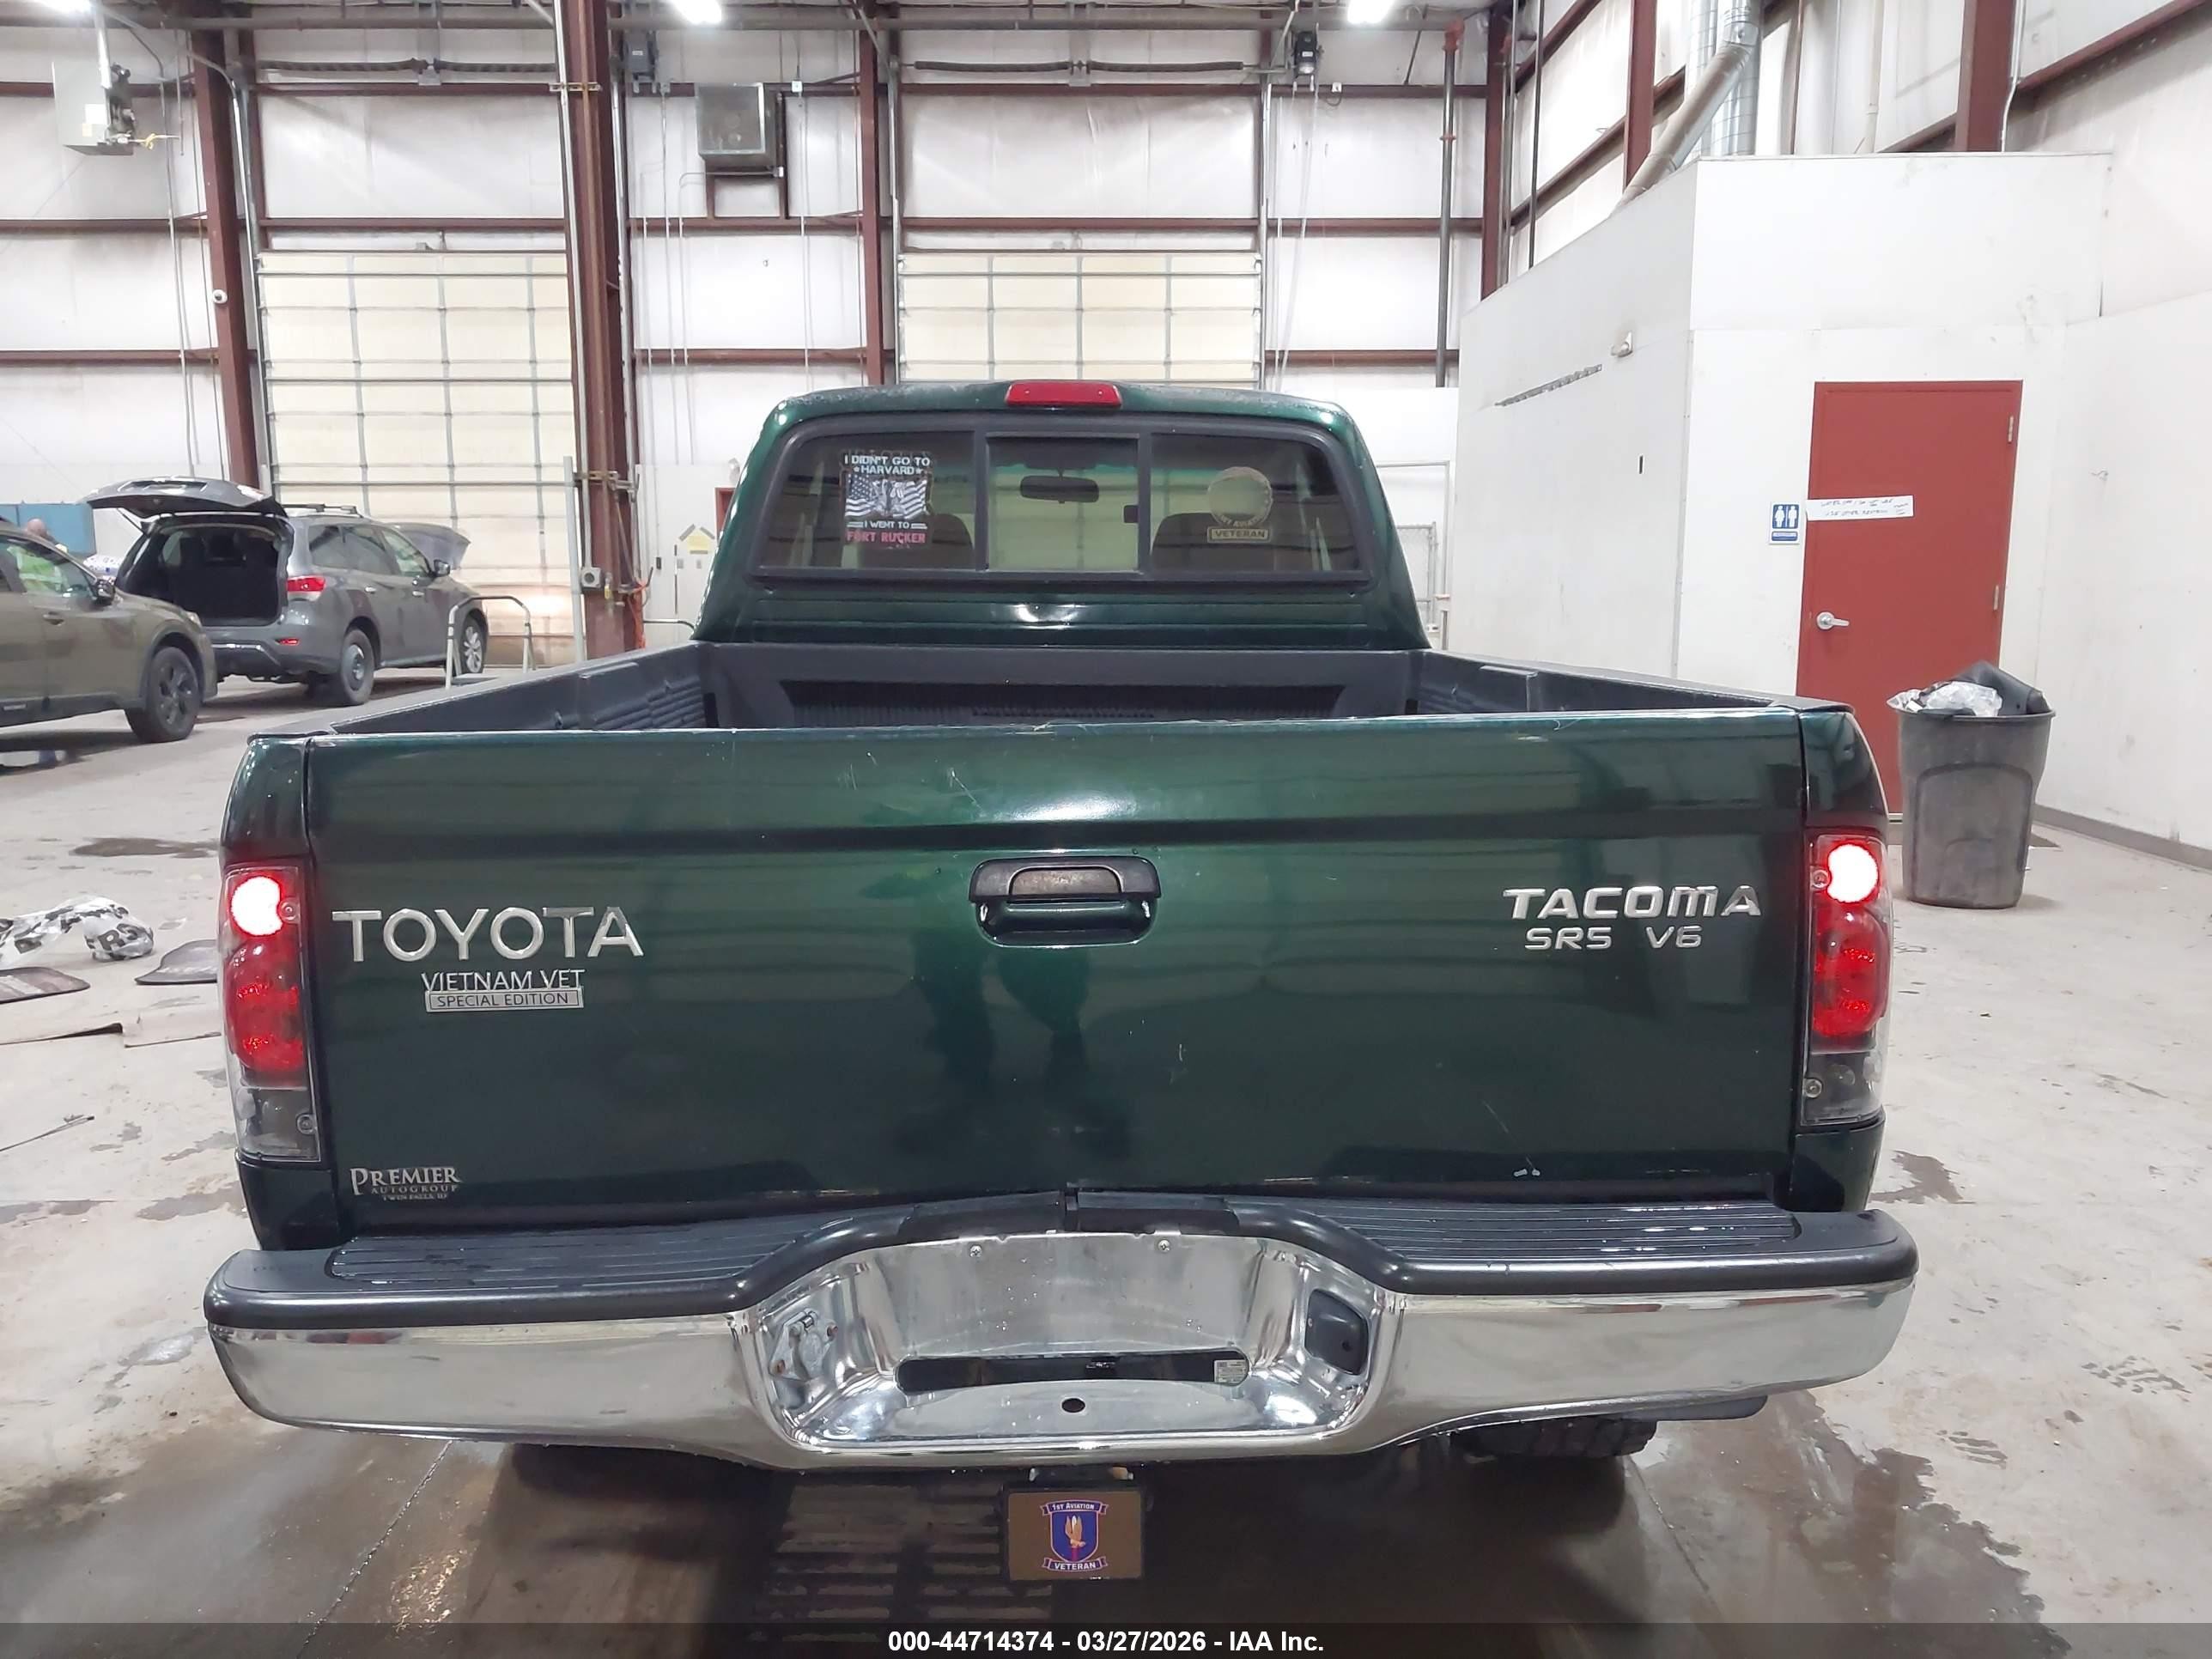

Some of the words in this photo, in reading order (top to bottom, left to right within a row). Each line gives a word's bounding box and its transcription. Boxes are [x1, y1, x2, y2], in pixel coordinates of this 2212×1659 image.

[844, 455, 848, 464] I
[851, 455, 888, 465] DIDN'T
[892, 457, 910, 466] GO
[915, 457, 930, 466] TO
[860, 465, 915, 475] HARVARD
[870, 520, 896, 529] WENT
[897, 520, 910, 529] TO
[847, 532, 876, 542] FORT
[881, 532, 925, 543] RUCKER
[1503, 885, 1761, 920] TACOMA
[331, 906, 644, 963] TOYOTA
[1645, 925, 1703, 949] V6
[421, 970, 532, 992] VIETNAM
[540, 969, 586, 988] VET
[437, 994, 500, 1007] SPECIAL
[504, 992, 569, 1006] EDITION
[349, 1166, 463, 1196] PREMIER
[1054, 1562, 1096, 1571] VETERAN
